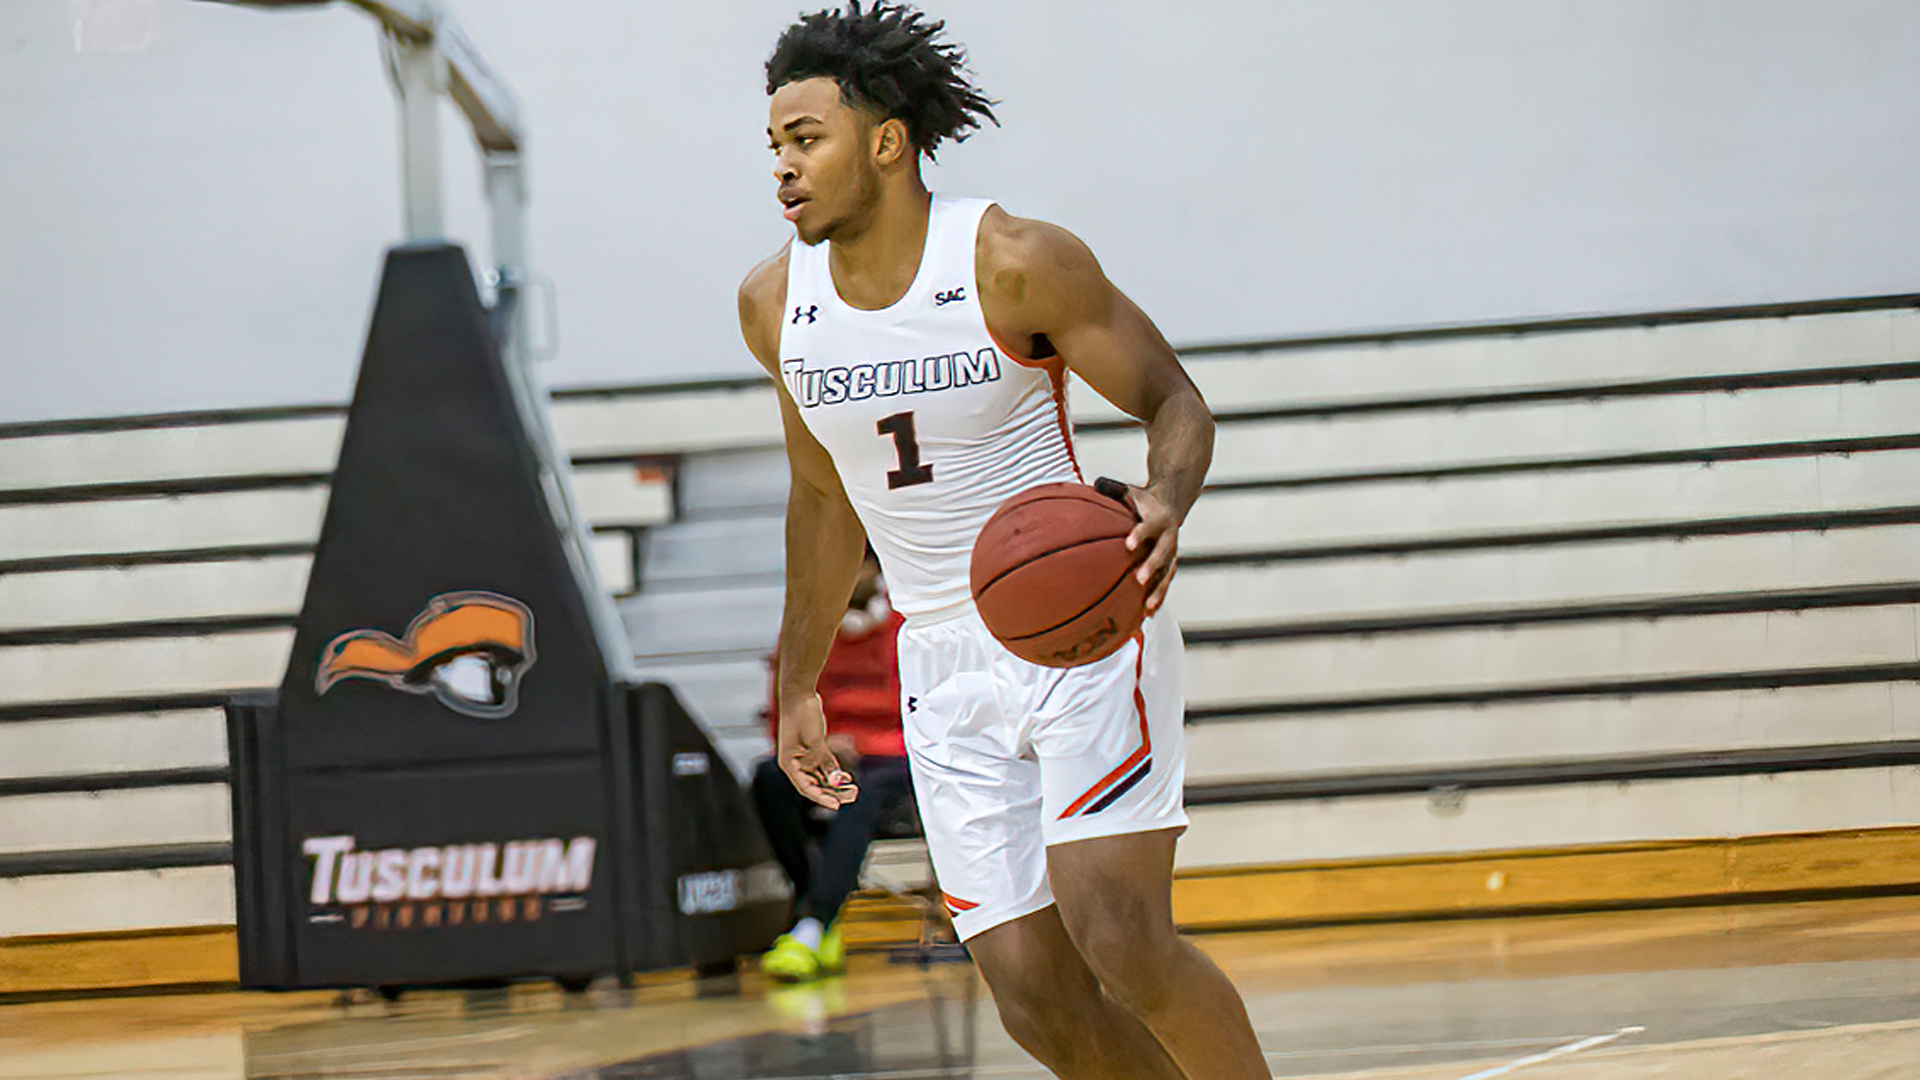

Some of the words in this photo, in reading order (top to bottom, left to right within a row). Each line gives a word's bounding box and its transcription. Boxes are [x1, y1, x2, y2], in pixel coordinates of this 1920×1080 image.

[935, 287, 966, 307] SAC
[784, 347, 1001, 407] TUSCULUM
[877, 411, 933, 490] 1
[302, 834, 597, 905] TUSCULUM
